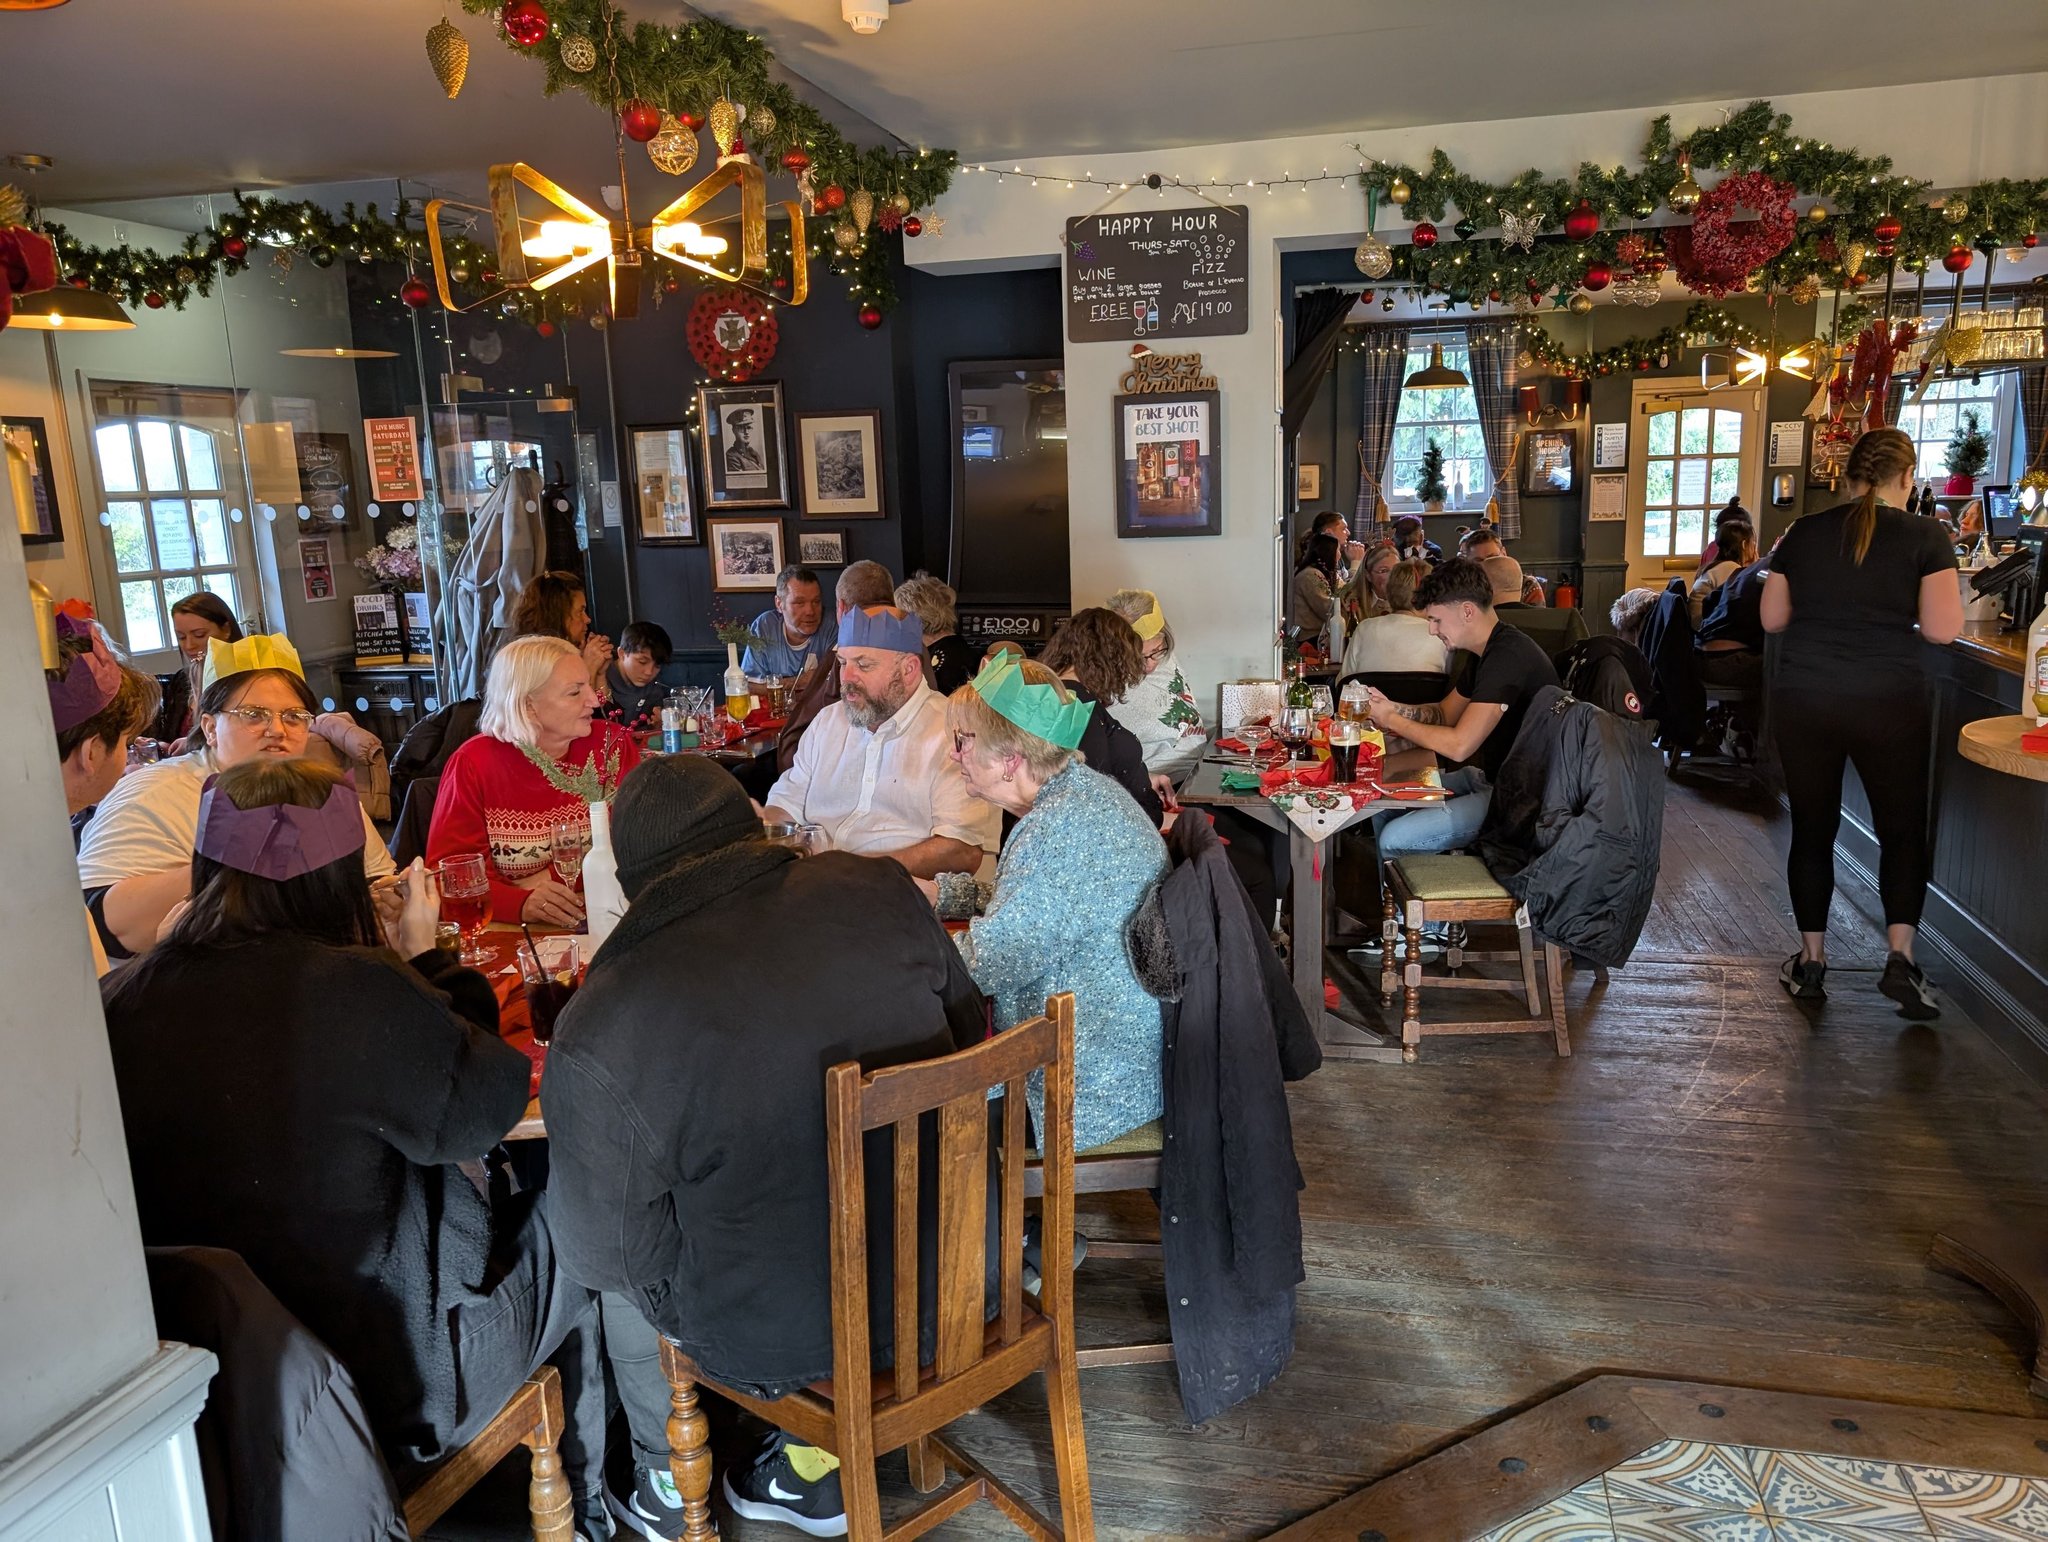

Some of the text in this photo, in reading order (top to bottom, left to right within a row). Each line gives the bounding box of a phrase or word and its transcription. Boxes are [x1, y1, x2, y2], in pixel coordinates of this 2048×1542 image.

[1099, 214, 1217, 236] HAPPY HOUR
[1078, 267, 1116, 281] WINE
[1192, 262, 1226, 275] FIZZ
[1072, 285, 1086, 295] Buy
[1091, 286, 1103, 294] any
[1107, 284, 1112, 292] 2
[1117, 283, 1134, 291] large
[1073, 295, 1084, 303] get
[1091, 302, 1128, 319] FREE
[1135, 352, 1203, 378] Merry
[1119, 370, 1218, 395] Christmas
[1135, 405, 1199, 421] TAKE YOUR
[1135, 420, 1199, 436] BEST SHOT!
[372, 432, 410, 440] SATURDAYS
[1536, 439, 1564, 448] OPENING
[1539, 447, 1561, 455] HOURS
[355, 595, 382, 603] FOOD
[356, 604, 384, 612] DRINKS
[982, 617, 1030, 628] £100
